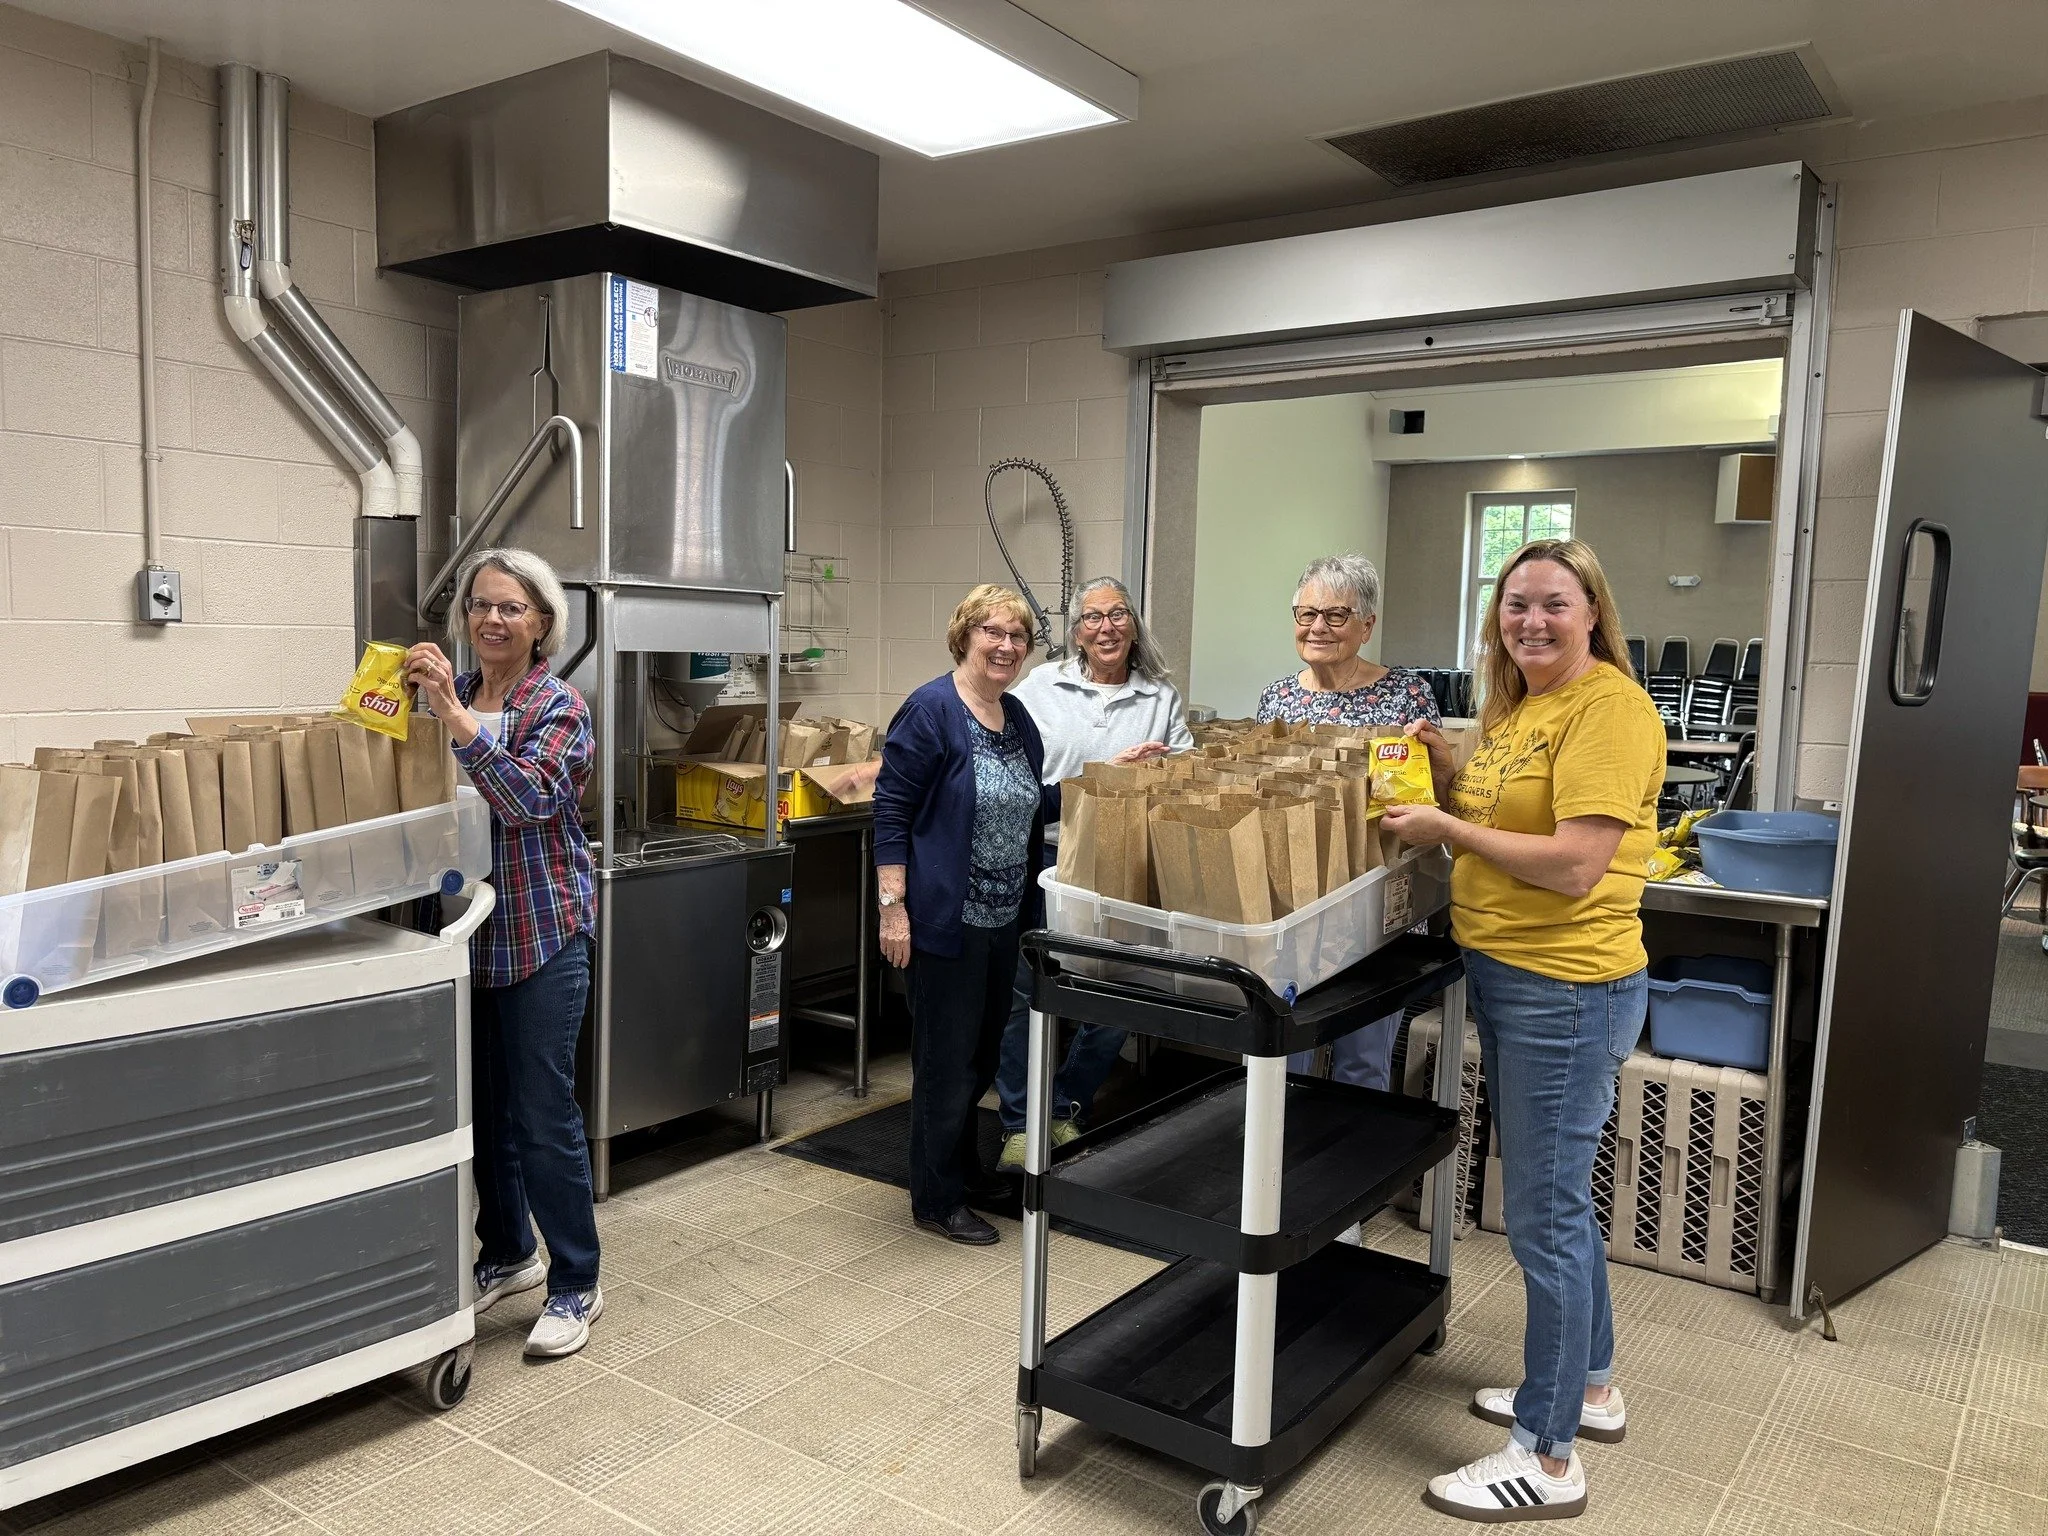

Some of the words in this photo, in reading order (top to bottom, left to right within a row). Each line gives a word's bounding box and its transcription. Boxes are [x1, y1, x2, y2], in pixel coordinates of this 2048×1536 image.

[613, 315, 619, 330] AM
[673, 362, 731, 386] HOBART
[1458, 773, 1489, 784] KENTUCKY
[777, 800, 789, 816] 50
